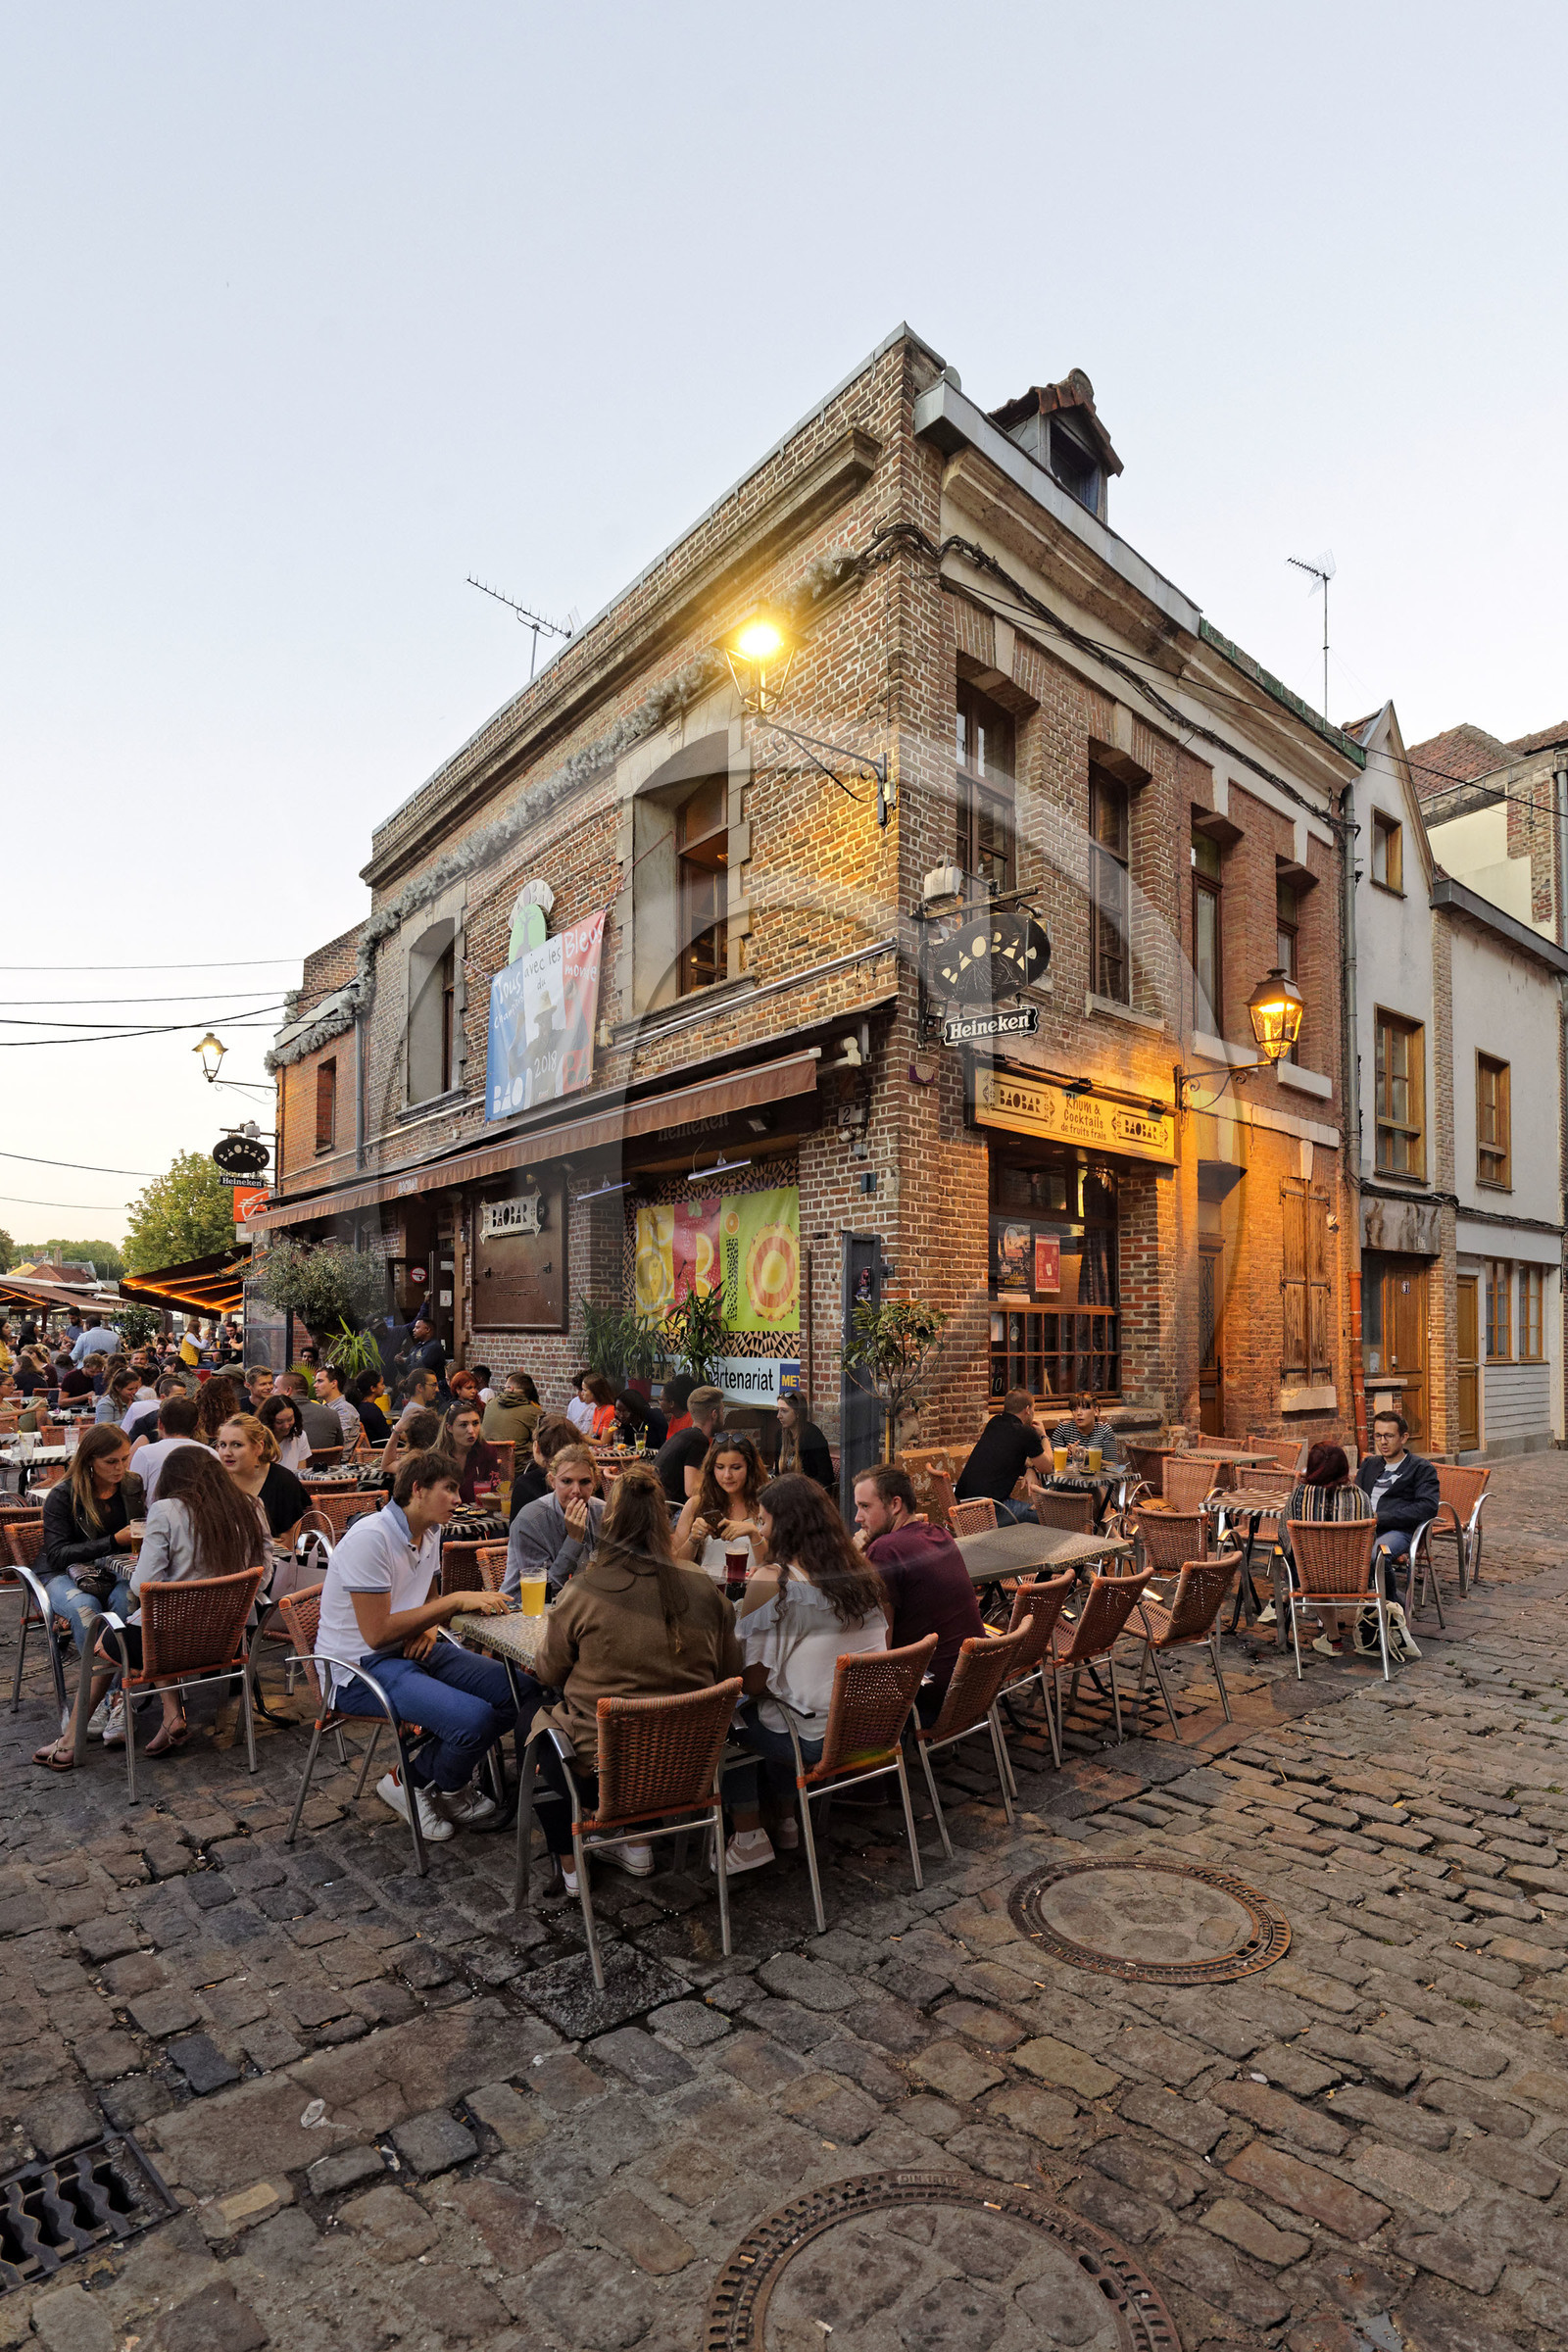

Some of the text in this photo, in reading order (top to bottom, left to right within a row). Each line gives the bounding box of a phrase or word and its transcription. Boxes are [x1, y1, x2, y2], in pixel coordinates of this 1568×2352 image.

[493, 918, 604, 1004] Tous avec les Bleus
[537, 978, 546, 991] du
[950, 1013, 1030, 1040] Heineken
[534, 1050, 558, 1079] 2018
[842, 1106, 852, 1124] 2
[1000, 1089, 1157, 1140] BAOBAR BAOBAR
[1065, 1092, 1101, 1116] Rhum &
[1063, 1108, 1103, 1129] Cocktails
[1060, 1122, 1106, 1141] de fruits frais
[221, 1177, 263, 1187] Heineken
[492, 1203, 528, 1228] BAOBAR
